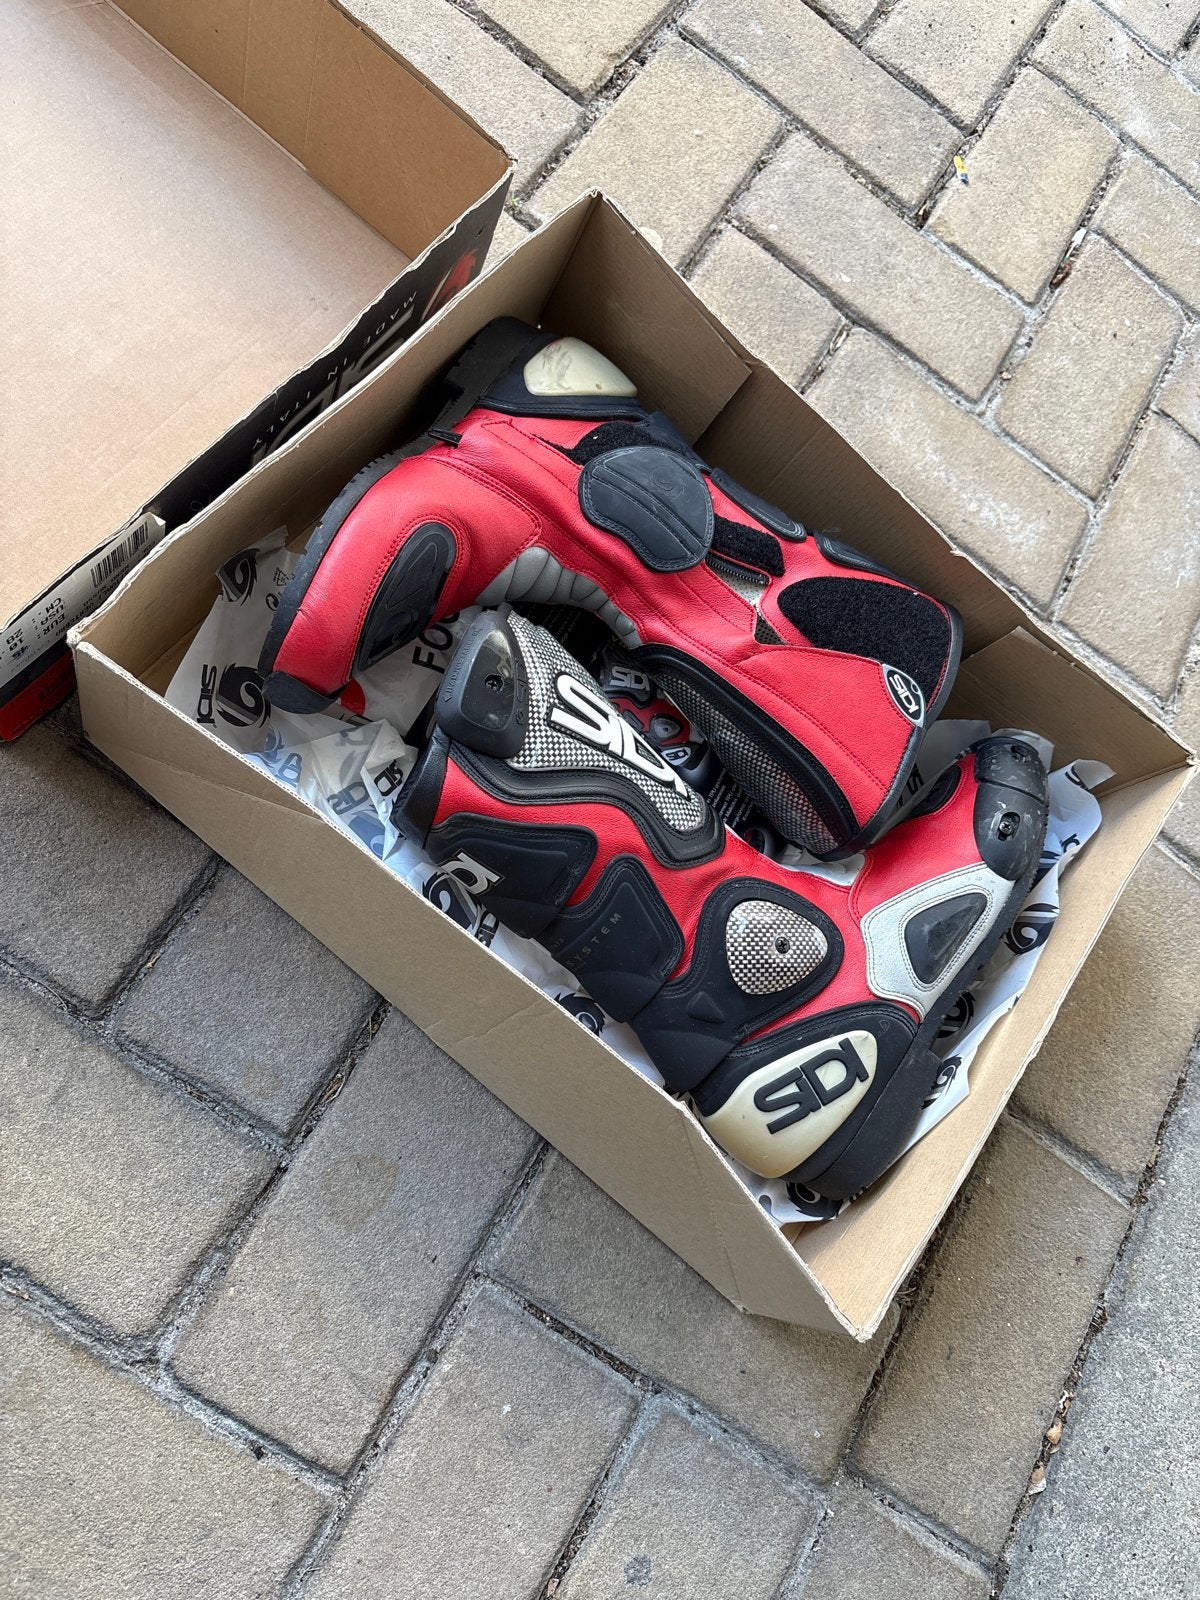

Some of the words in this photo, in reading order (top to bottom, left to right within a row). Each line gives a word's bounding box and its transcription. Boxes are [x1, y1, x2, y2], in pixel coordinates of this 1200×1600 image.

[363, 291, 417, 346] MADE
[327, 358, 348, 380] IN
[252, 391, 311, 450] ITALY
[6, 628, 24, 645] 28
[196, 663, 218, 725] SIDI
[610, 666, 651, 692] SIDI
[889, 674, 920, 714] SIDI
[551, 673, 689, 801] SIDI
[665, 747, 689, 762] SIDI
[567, 912, 622, 970] SYSTEM
[753, 1037, 870, 1135] SIDI
